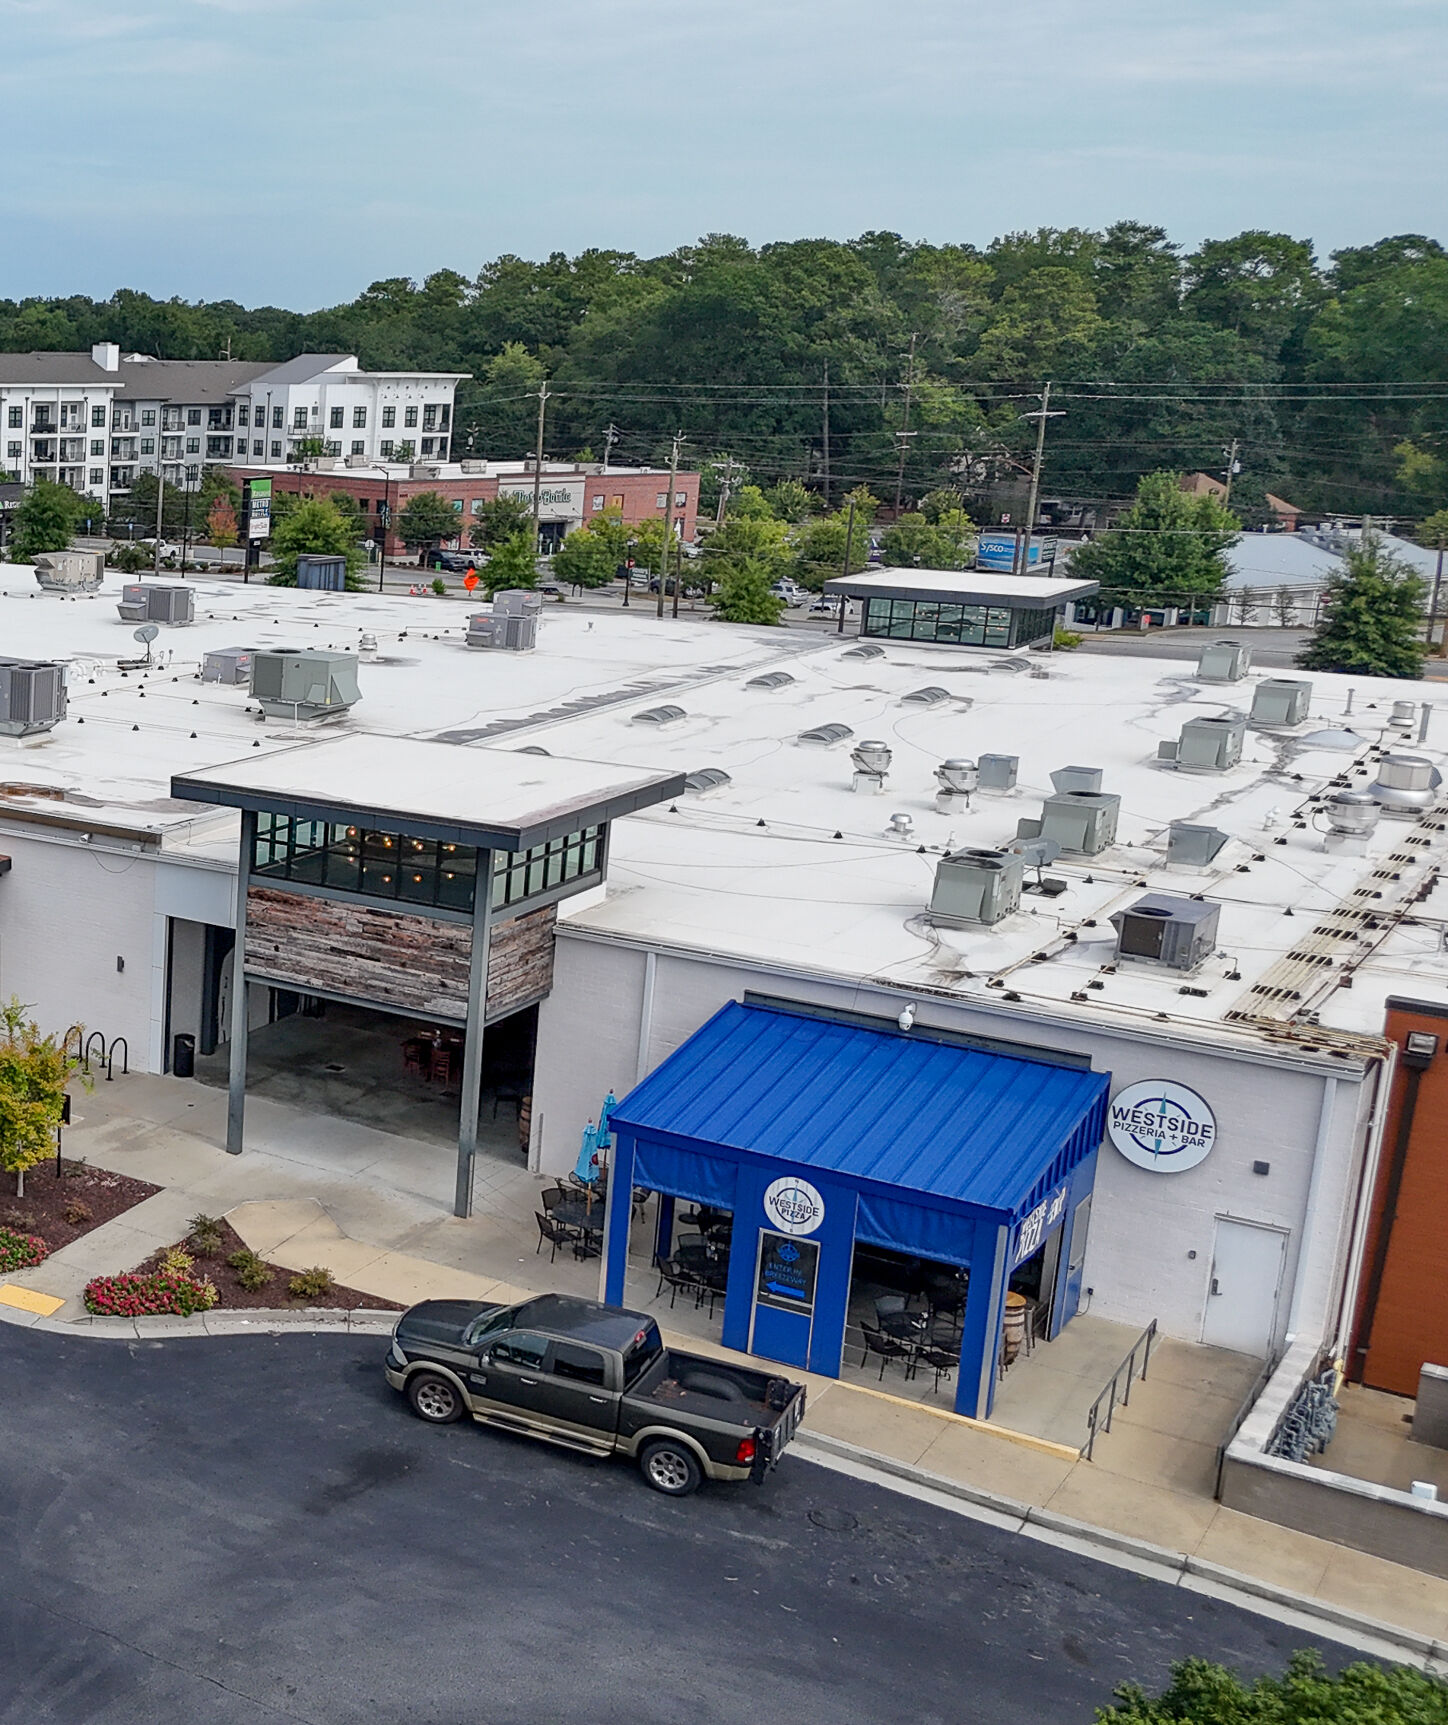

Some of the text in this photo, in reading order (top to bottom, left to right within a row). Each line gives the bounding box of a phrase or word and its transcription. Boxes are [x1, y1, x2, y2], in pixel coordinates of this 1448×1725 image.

[1112, 1105, 1213, 1139] WESTSIDE
[1113, 1121, 1166, 1139] PIZZERIA
[1181, 1135, 1206, 1148] BAR
[769, 1196, 820, 1217] WESTSIDE
[781, 1208, 806, 1220] PIZZA
